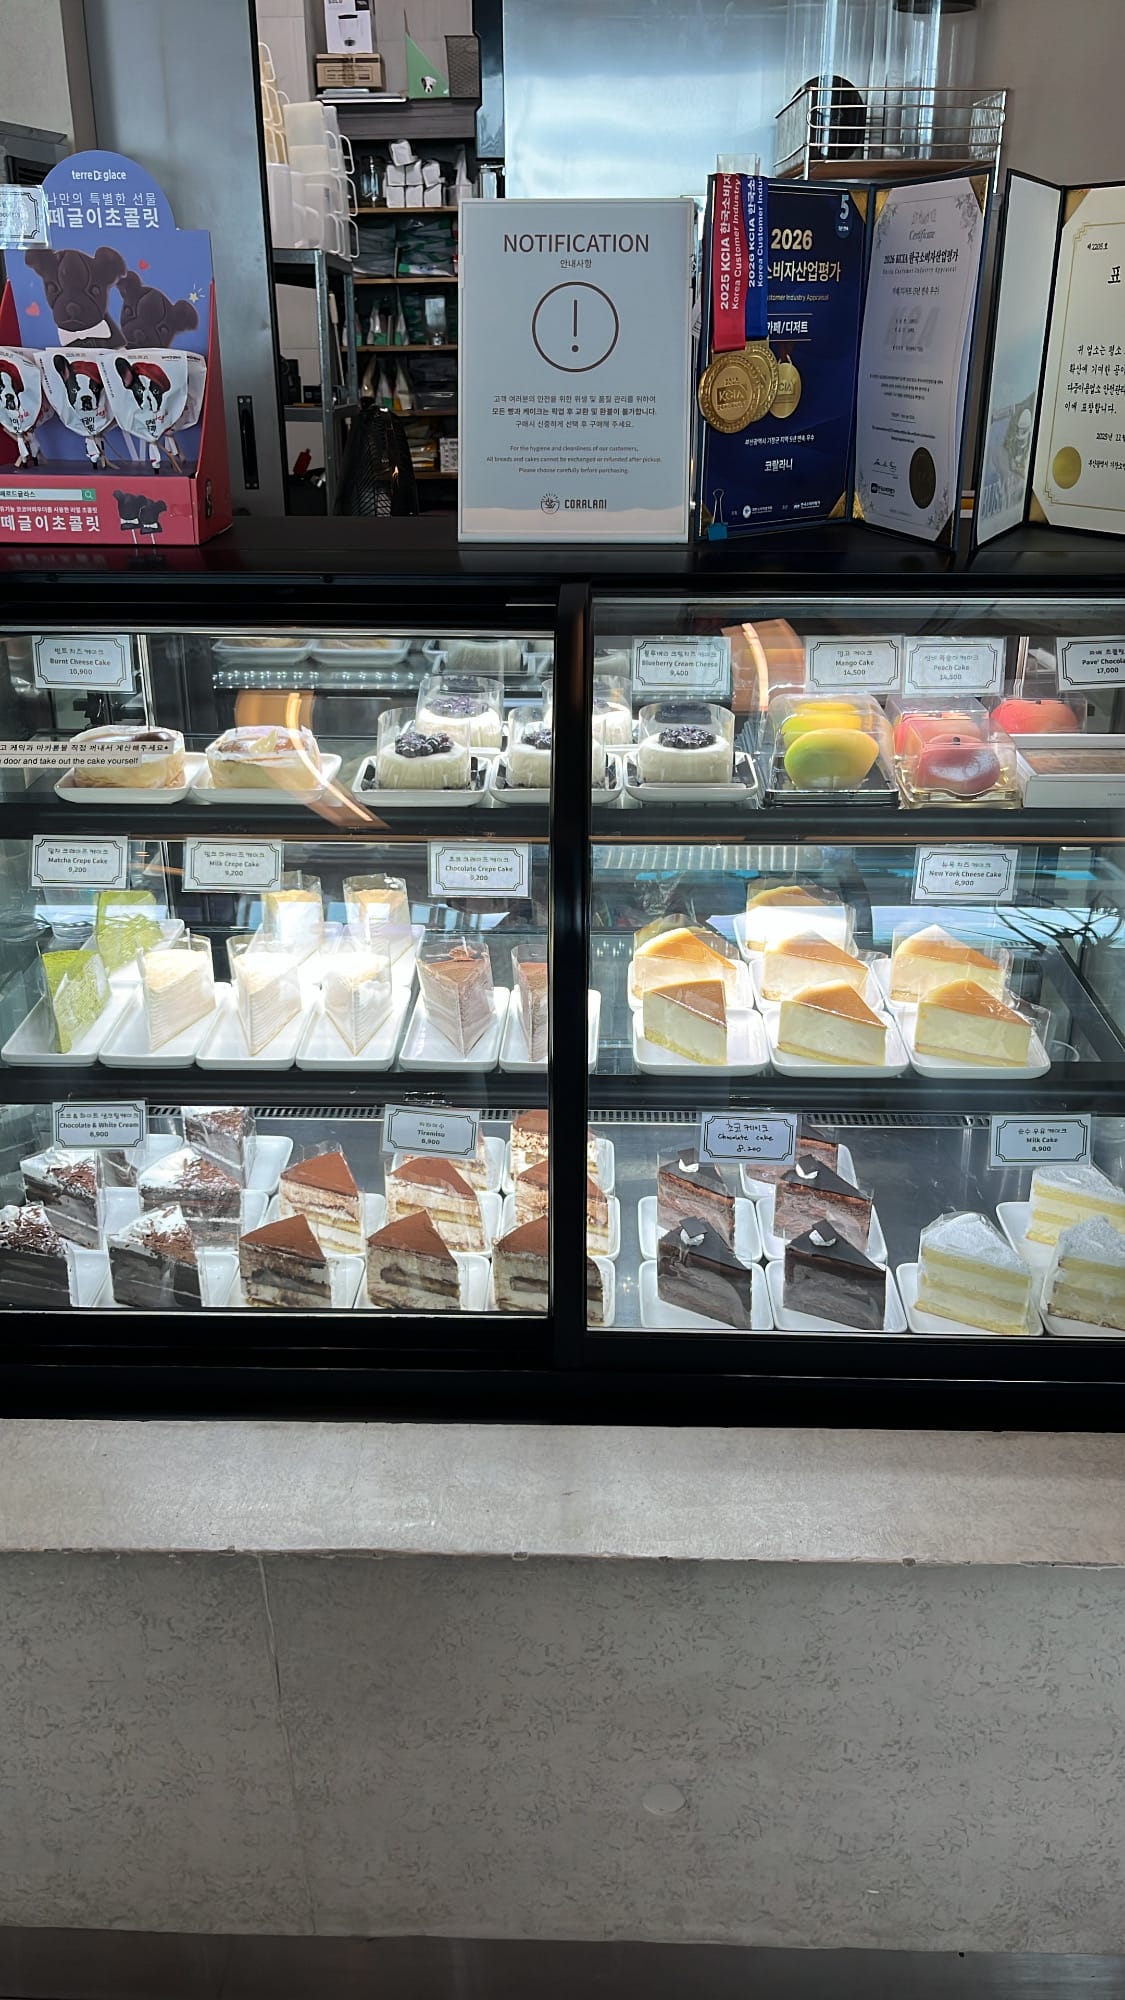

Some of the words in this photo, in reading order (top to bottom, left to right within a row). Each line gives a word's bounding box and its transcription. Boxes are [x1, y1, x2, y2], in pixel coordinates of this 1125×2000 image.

[47, 192, 83, 206] 나만의
[89, 192, 126, 207] 특별한
[133, 192, 157, 207] 선물
[733, 178, 741, 224] Industry
[840, 194, 849, 220] 5
[748, 218, 756, 251] KCIA
[771, 229, 813, 251] 2026
[504, 234, 649, 253] NOTIFICATION
[720, 237, 731, 271] KCIA
[732, 226, 742, 277] Customer
[560, 259, 592, 269] 안내사항
[748, 254, 756, 288] 2026
[1107, 265, 1121, 284] 표
[720, 275, 731, 310] 2025
[731, 280, 741, 310] Korea
[1077, 344, 1084, 356] 귀
[1086, 344, 1106, 357] 업소는
[492, 407, 505, 415] 모든
[523, 407, 549, 415] 케이크는
[1081, 401, 1117, 414] 표창합니다.
[764, 457, 793, 472] 코랄라니
[564, 499, 607, 510] CORALANI
[0, 514, 101, 532] 떼글이초콜릿
[641, 660, 672, 668] Blueberry
[1097, 667, 1118, 675] 17,000
[69, 668, 92, 676] 10,900
[3, 757, 21, 766] door
[23, 757, 38, 766] and
[39, 757, 57, 766] take
[58, 757, 71, 766] out
[72, 757, 85, 766] the
[86, 757, 106, 766] cake
[107, 757, 139, 767] yourself
[72, 857, 90, 865] Crepe
[68, 866, 86, 874] 9,200
[417, 1129, 445, 1137] Tiramisu
[744, 1123, 768, 1132] 케이크
[1032, 1145, 1051, 1153] 8,900
